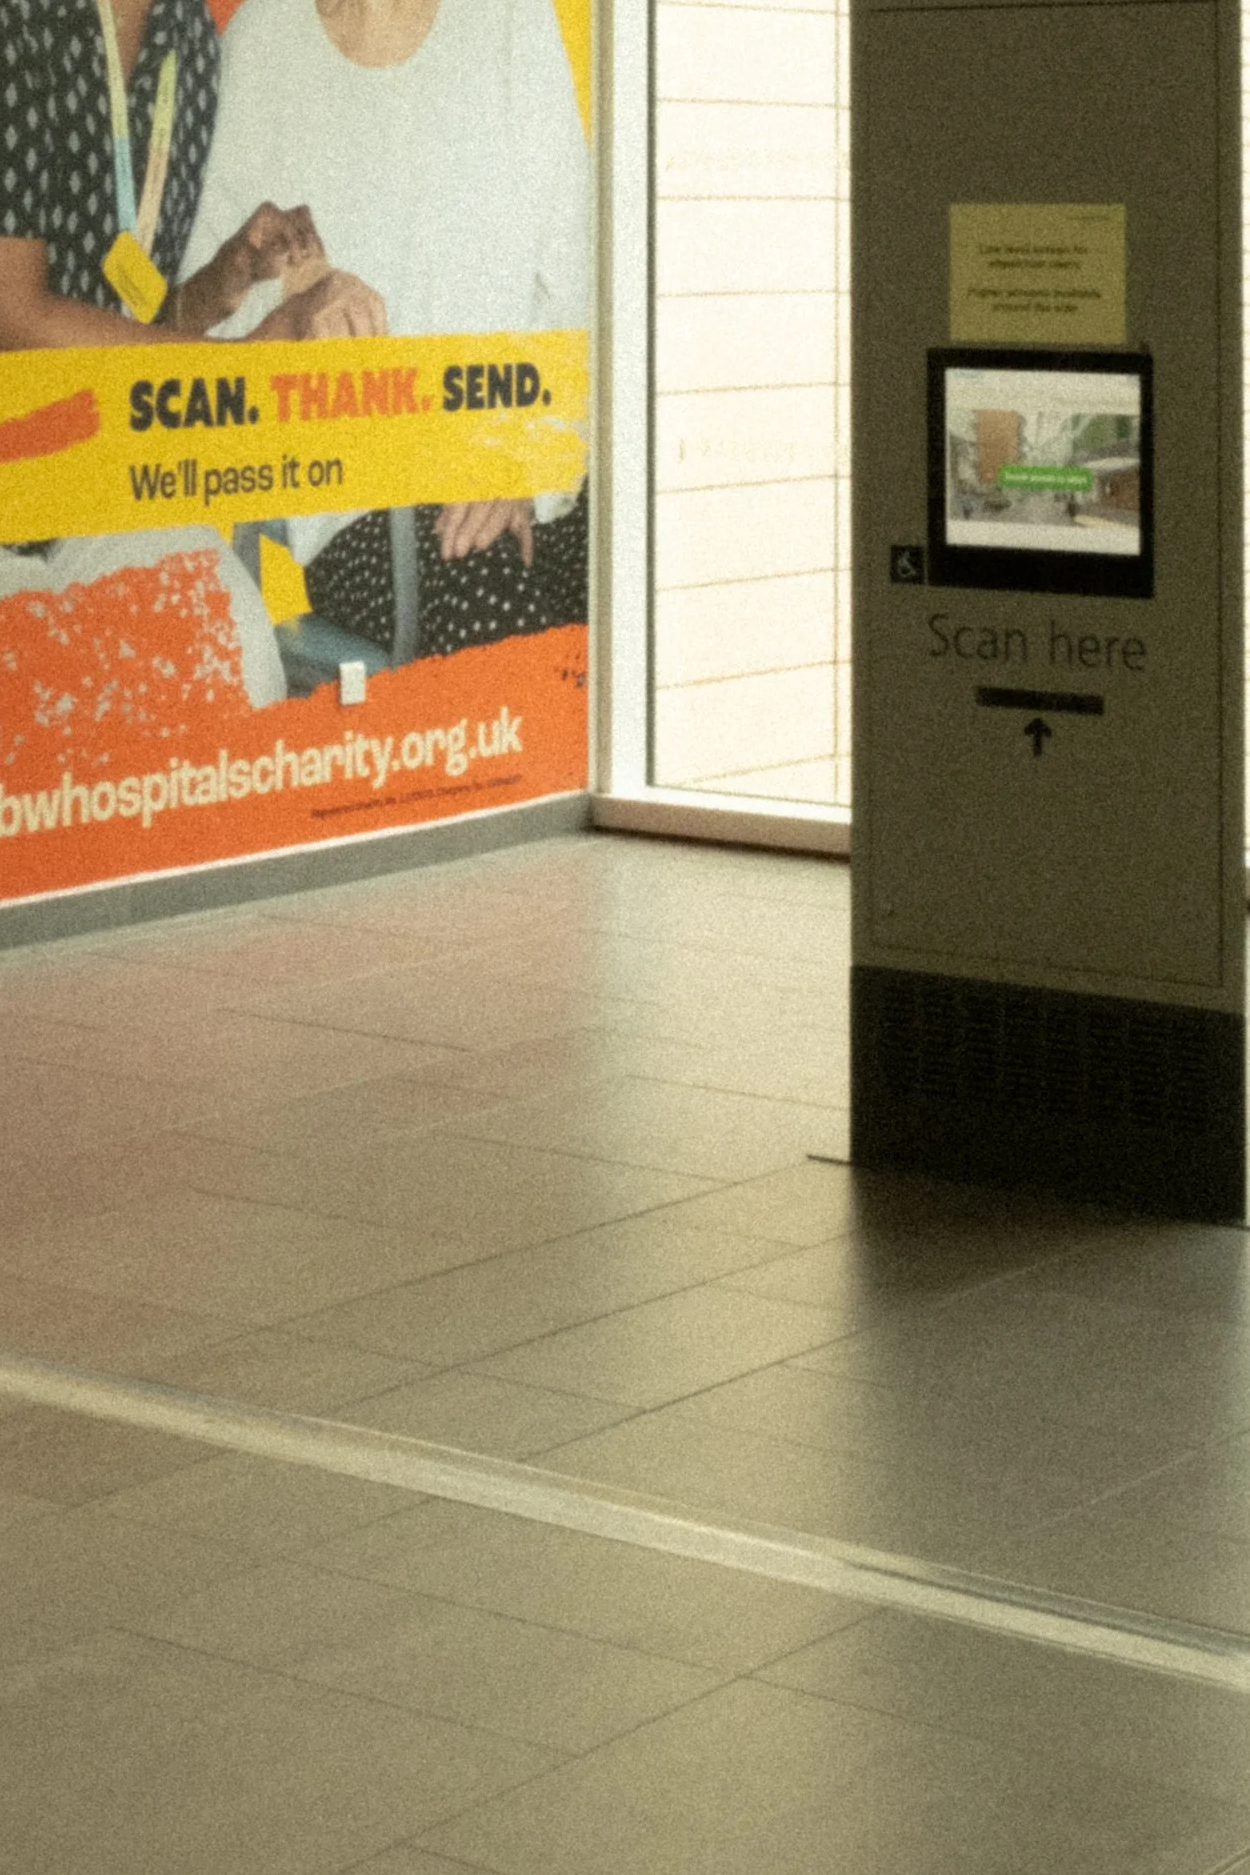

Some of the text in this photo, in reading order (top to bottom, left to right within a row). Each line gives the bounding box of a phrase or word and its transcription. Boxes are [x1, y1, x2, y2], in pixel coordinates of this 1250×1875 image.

[129, 362, 551, 431] SCAN. THANK. SEND.
[129, 454, 344, 505] We'll pass it on
[927, 612, 1147, 672] Scan here
